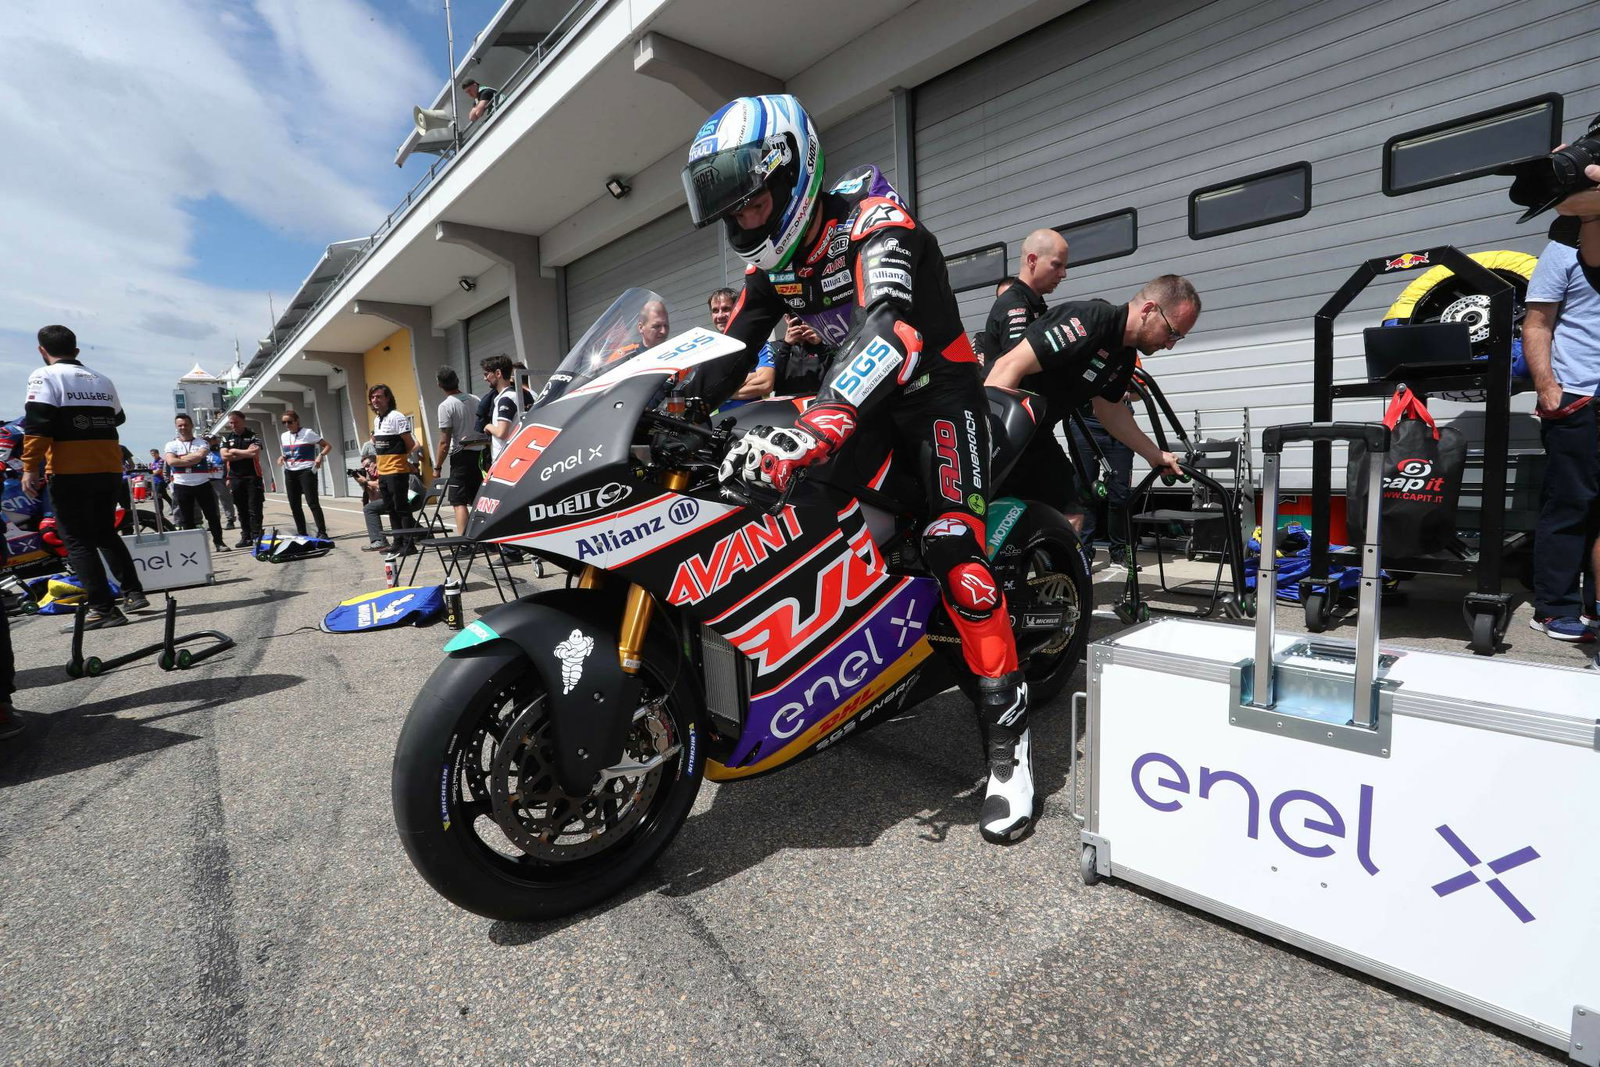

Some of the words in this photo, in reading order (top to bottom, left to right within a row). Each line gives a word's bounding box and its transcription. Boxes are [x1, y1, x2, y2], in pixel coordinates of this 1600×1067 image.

[808, 139, 817, 170] SHOEI
[823, 276, 841, 289] Allianz
[871, 270, 904, 281] Allianz
[657, 335, 715, 361] SGS
[836, 341, 890, 396] SGS
[862, 373, 884, 397] INDUSTRIAL
[883, 356, 900, 374] SERVICES
[489, 423, 563, 486] 6
[540, 449, 583, 481] enel
[934, 419, 962, 504] AJO
[964, 410, 982, 489] ENERGICA
[575, 516, 666, 560] Allianz
[989, 506, 1023, 546] MOTOREX
[132, 550, 172, 572] nel
[665, 503, 804, 606] AVANT
[1036, 616, 1059, 624] MICHELIN
[770, 627, 883, 738] enel
[820, 687, 876, 732] DHL
[688, 736, 696, 772] MICHELIN
[441, 768, 449, 814] MICHELIN
[1131, 752, 1381, 877] enel
[1431, 823, 1542, 924] X
